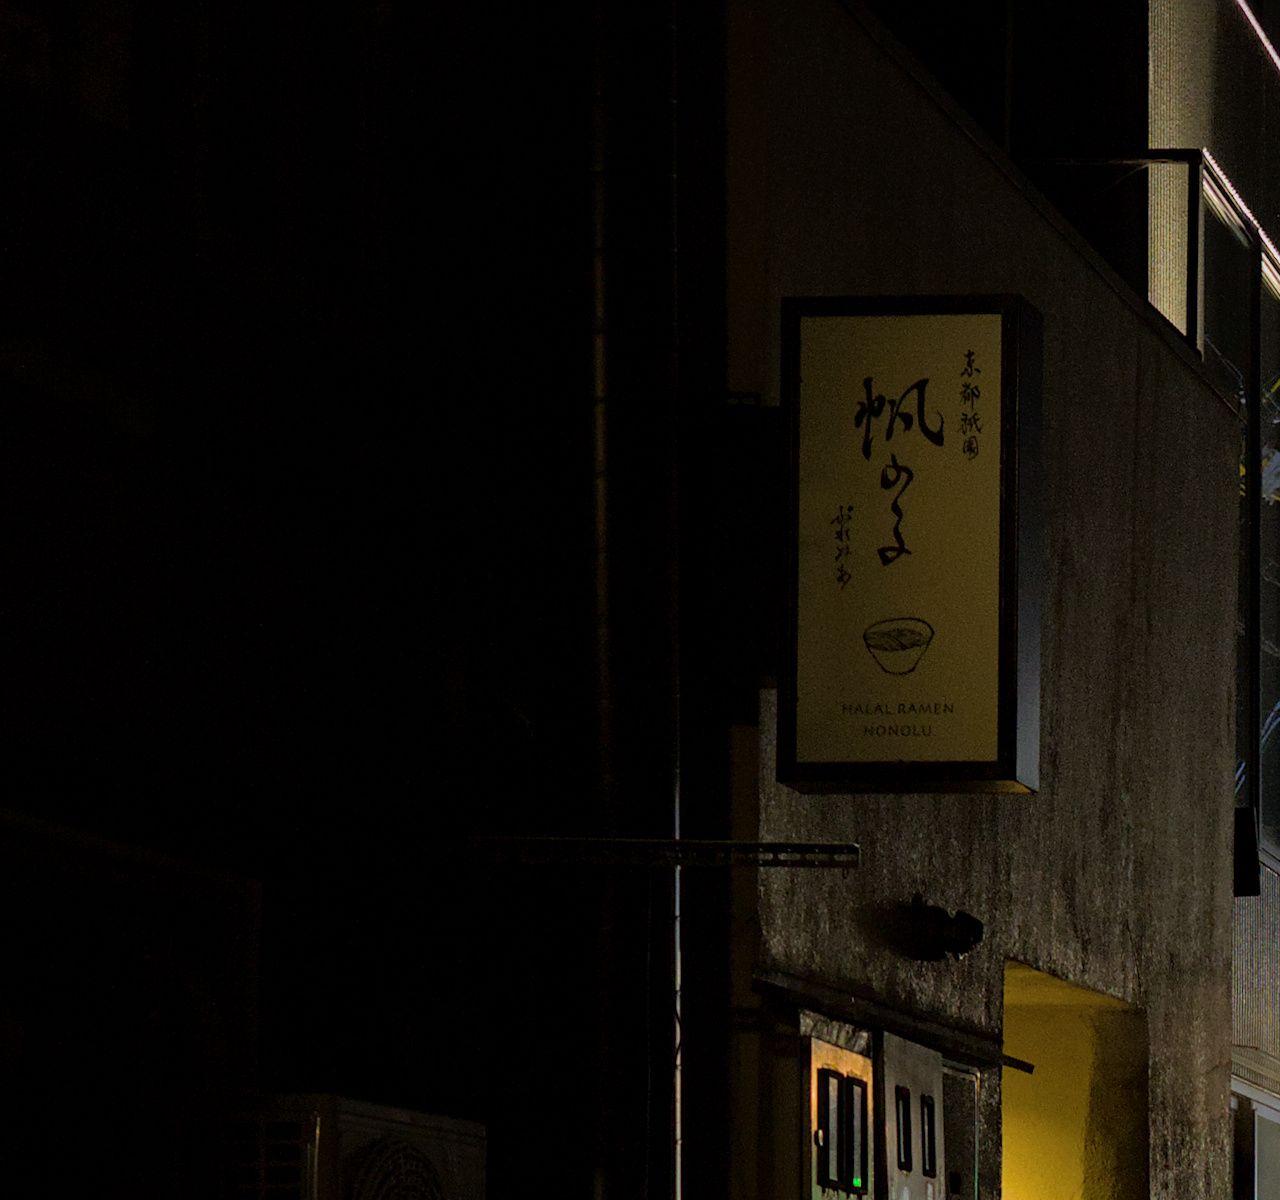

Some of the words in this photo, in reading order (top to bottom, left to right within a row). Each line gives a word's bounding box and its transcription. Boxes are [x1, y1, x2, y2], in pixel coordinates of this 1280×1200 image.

[841, 703, 894, 715] HALAL
[897, 703, 954, 715] RAMEN
[863, 724, 932, 737] HONOLU
